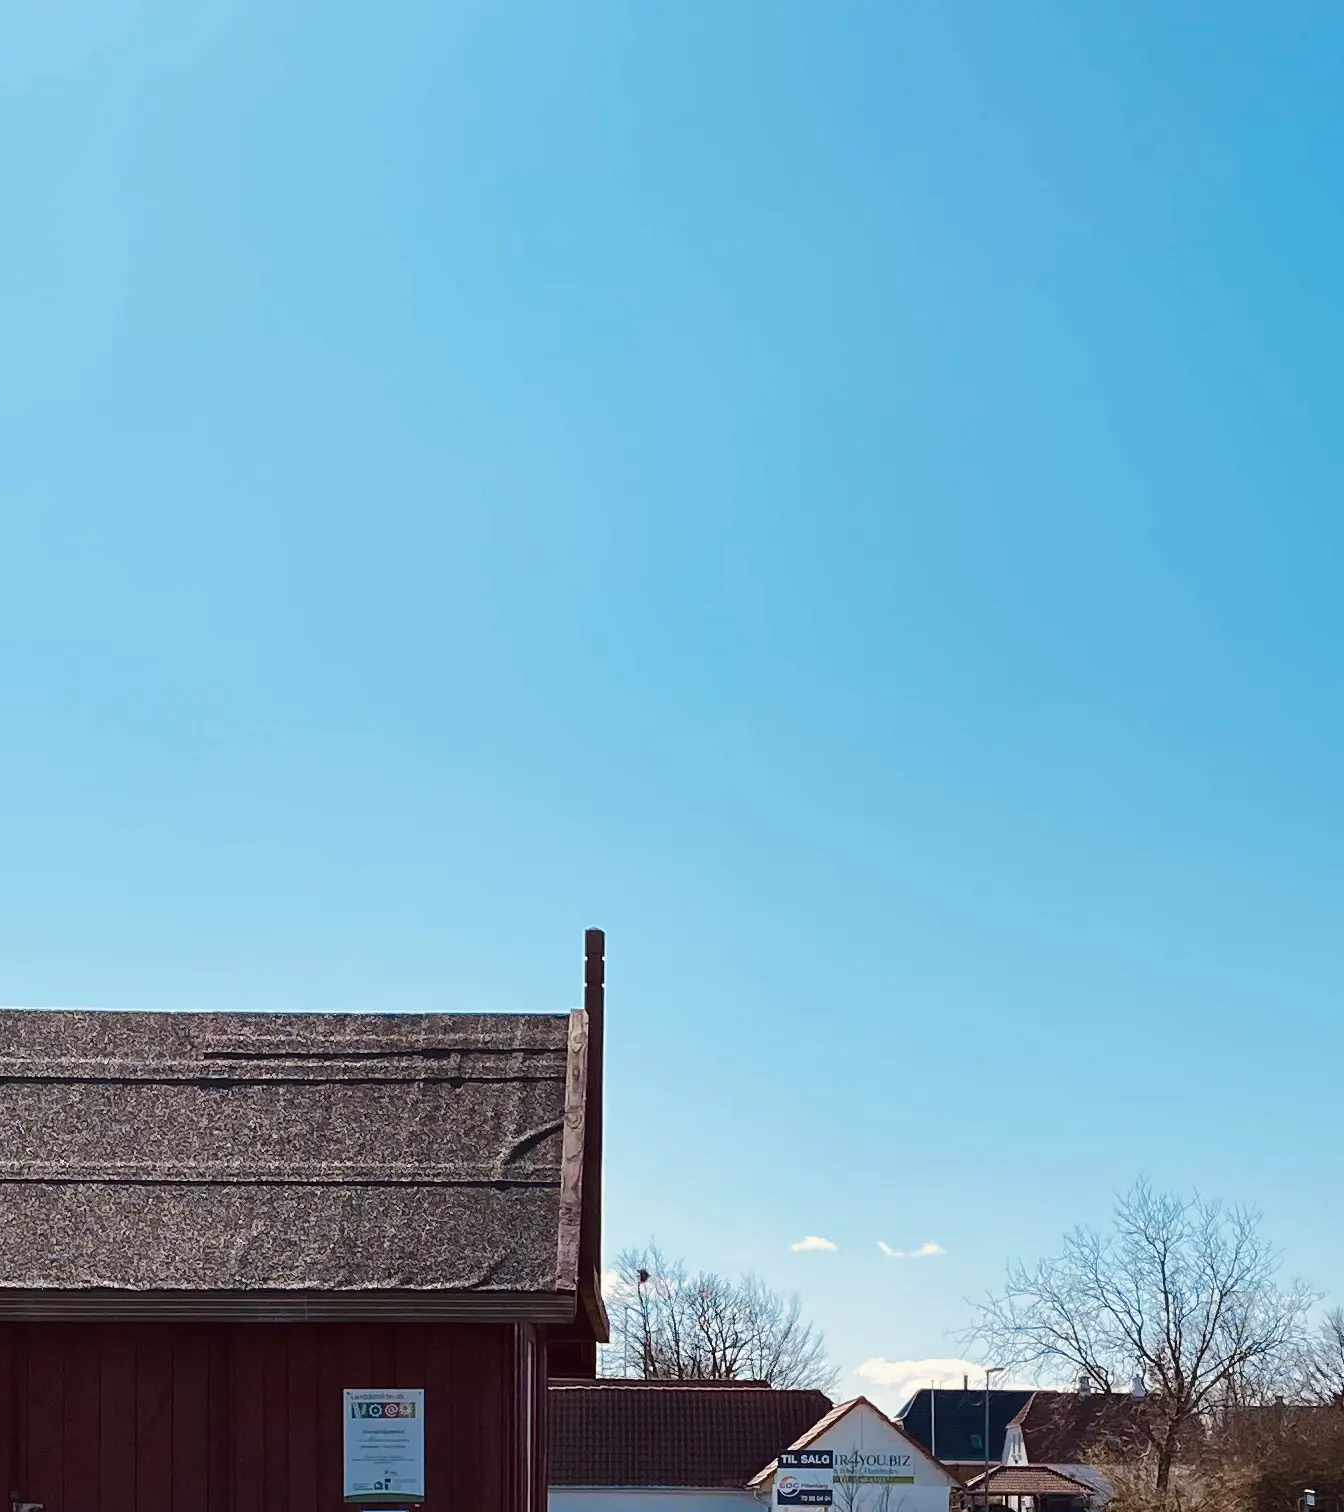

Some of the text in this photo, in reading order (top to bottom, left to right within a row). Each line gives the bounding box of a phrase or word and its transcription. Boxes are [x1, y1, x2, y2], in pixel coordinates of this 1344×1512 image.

[780, 1454, 830, 1464] TIL SALG
[834, 1450, 912, 1467] IR4YOU.BIZ
